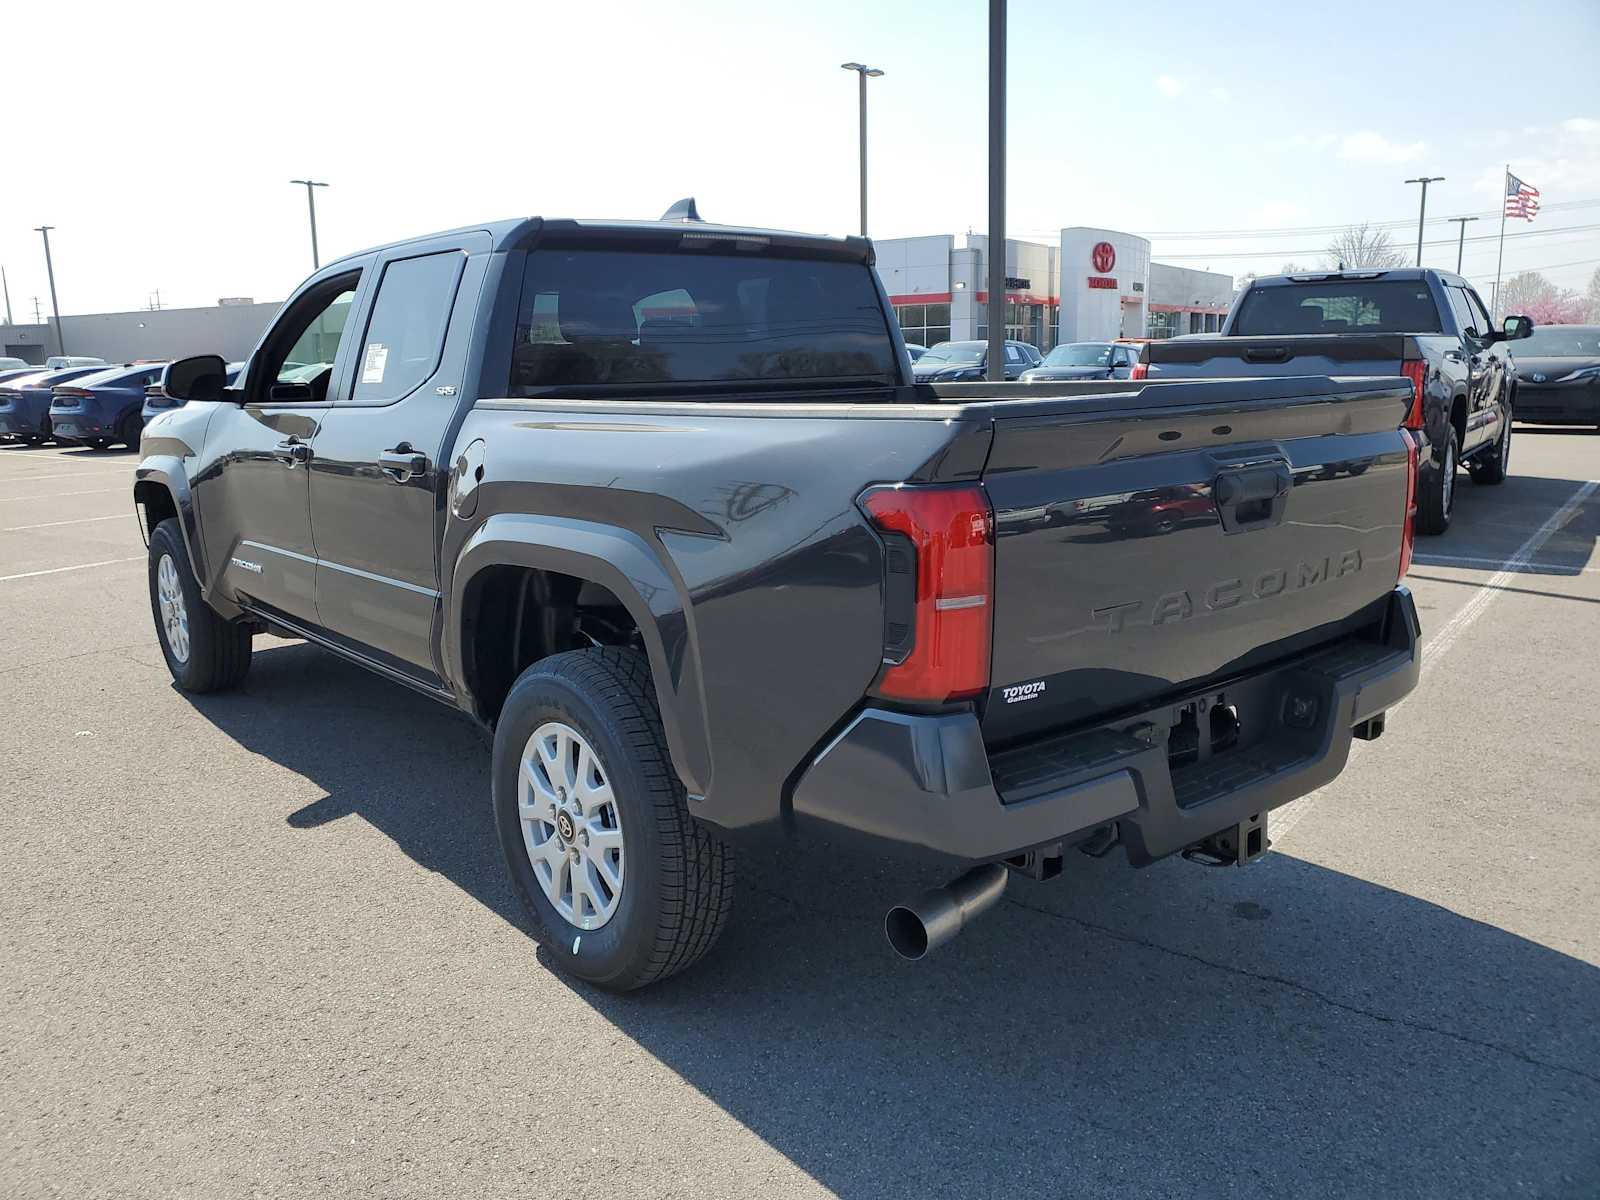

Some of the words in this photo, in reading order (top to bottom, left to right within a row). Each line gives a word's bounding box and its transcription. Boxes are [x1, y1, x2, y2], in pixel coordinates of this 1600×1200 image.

[231, 557, 264, 575] TACOMA
[1091, 549, 1362, 634] TACOMA
[1003, 681, 1046, 699] TOYOTA
[1007, 693, 1039, 704] Gallatin
